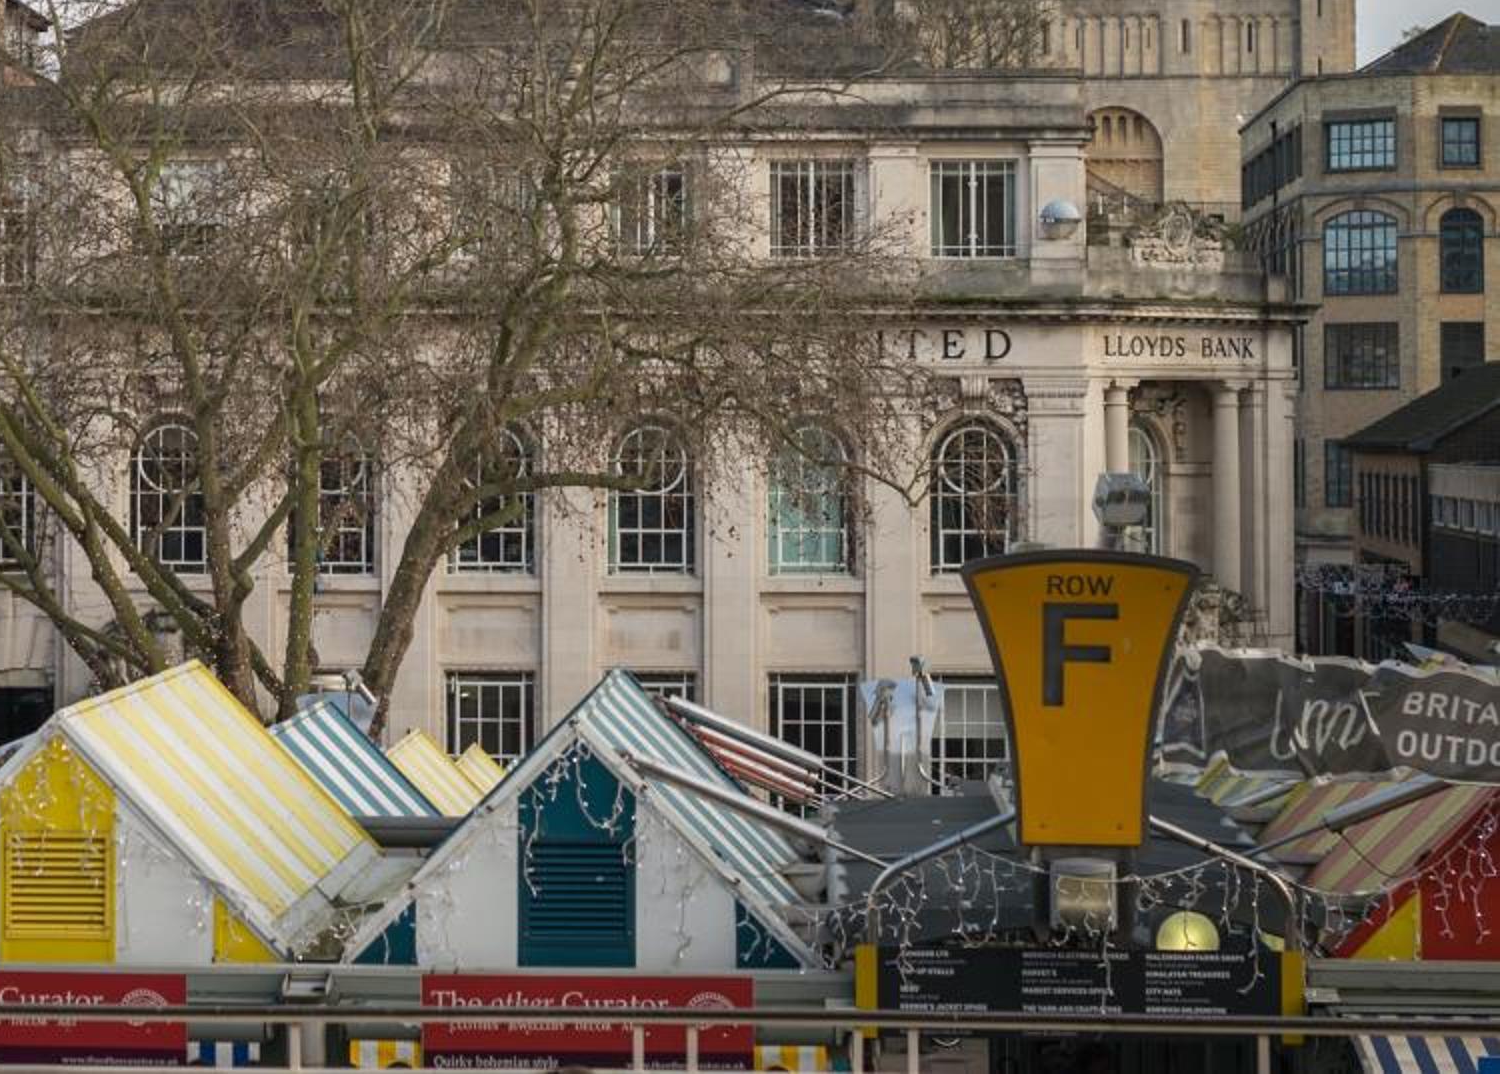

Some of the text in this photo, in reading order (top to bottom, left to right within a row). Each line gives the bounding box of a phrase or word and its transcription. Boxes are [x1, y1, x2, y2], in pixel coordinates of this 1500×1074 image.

[876, 328, 1012, 360] ITED
[1103, 335, 1255, 360] LLOYDS BANK
[1046, 575, 1114, 596] ROW
[1042, 602, 1120, 707] F
[1402, 691, 1500, 726] BRITA
[430, 989, 669, 1009] The other Curator
[433, 1054, 473, 1069] Quirky
[474, 1053, 531, 1068] bohemian
